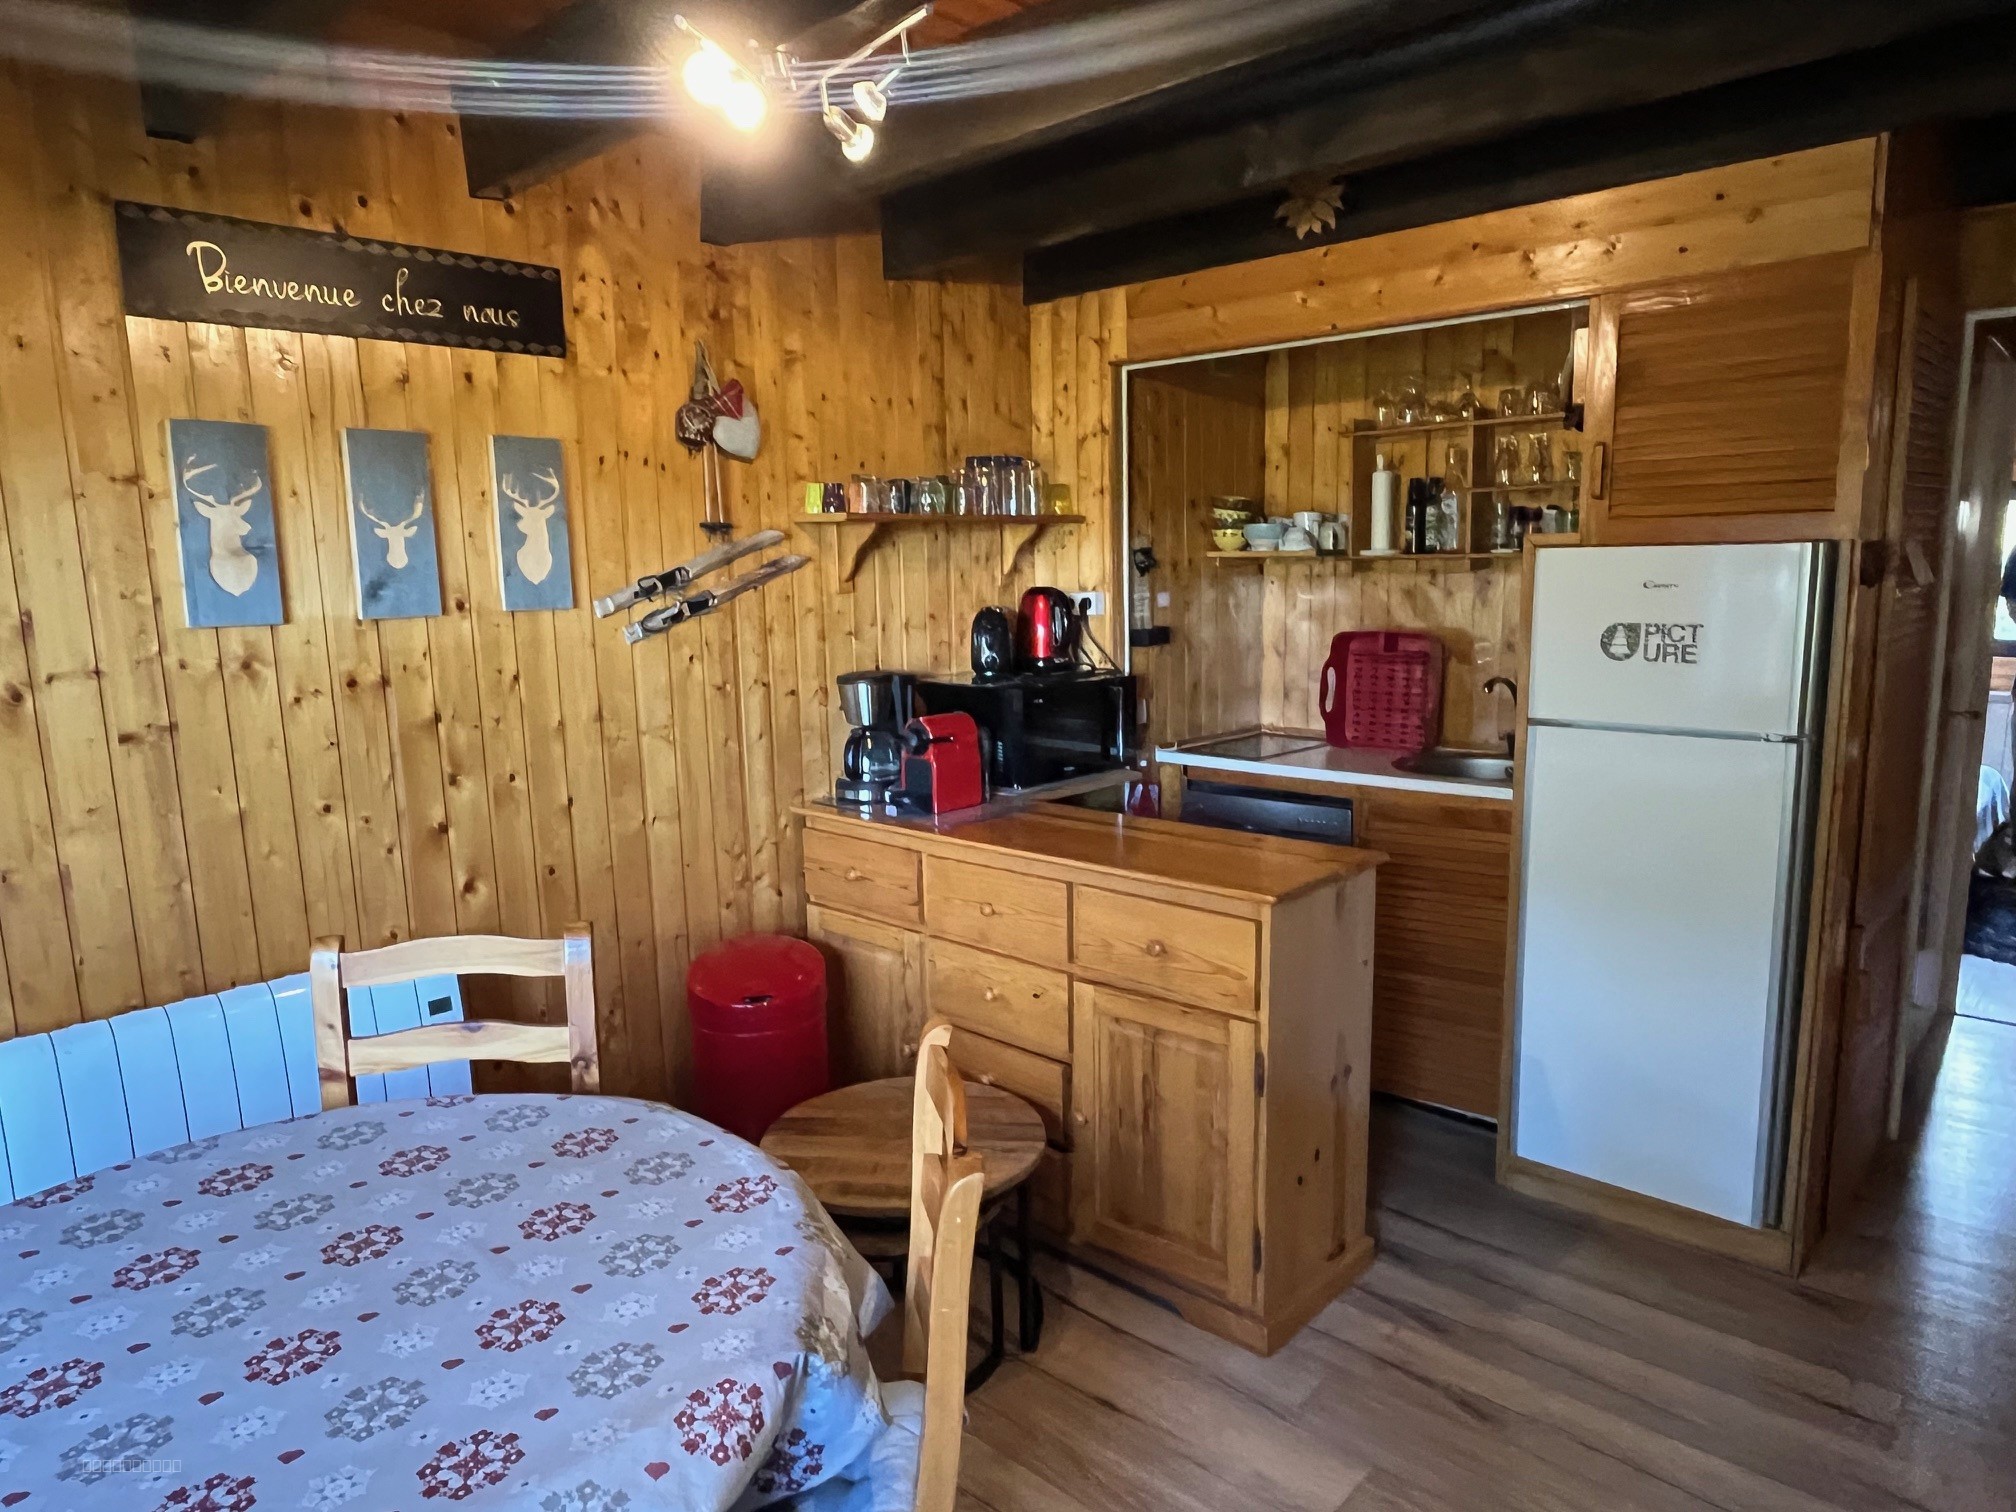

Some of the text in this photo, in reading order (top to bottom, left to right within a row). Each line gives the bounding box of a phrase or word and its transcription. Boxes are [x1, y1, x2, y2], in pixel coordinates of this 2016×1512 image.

[186, 240, 361, 308] Bienvenue
[381, 267, 444, 318] chez
[1644, 623, 1704, 644] PICT
[1643, 643, 1698, 663] URE
